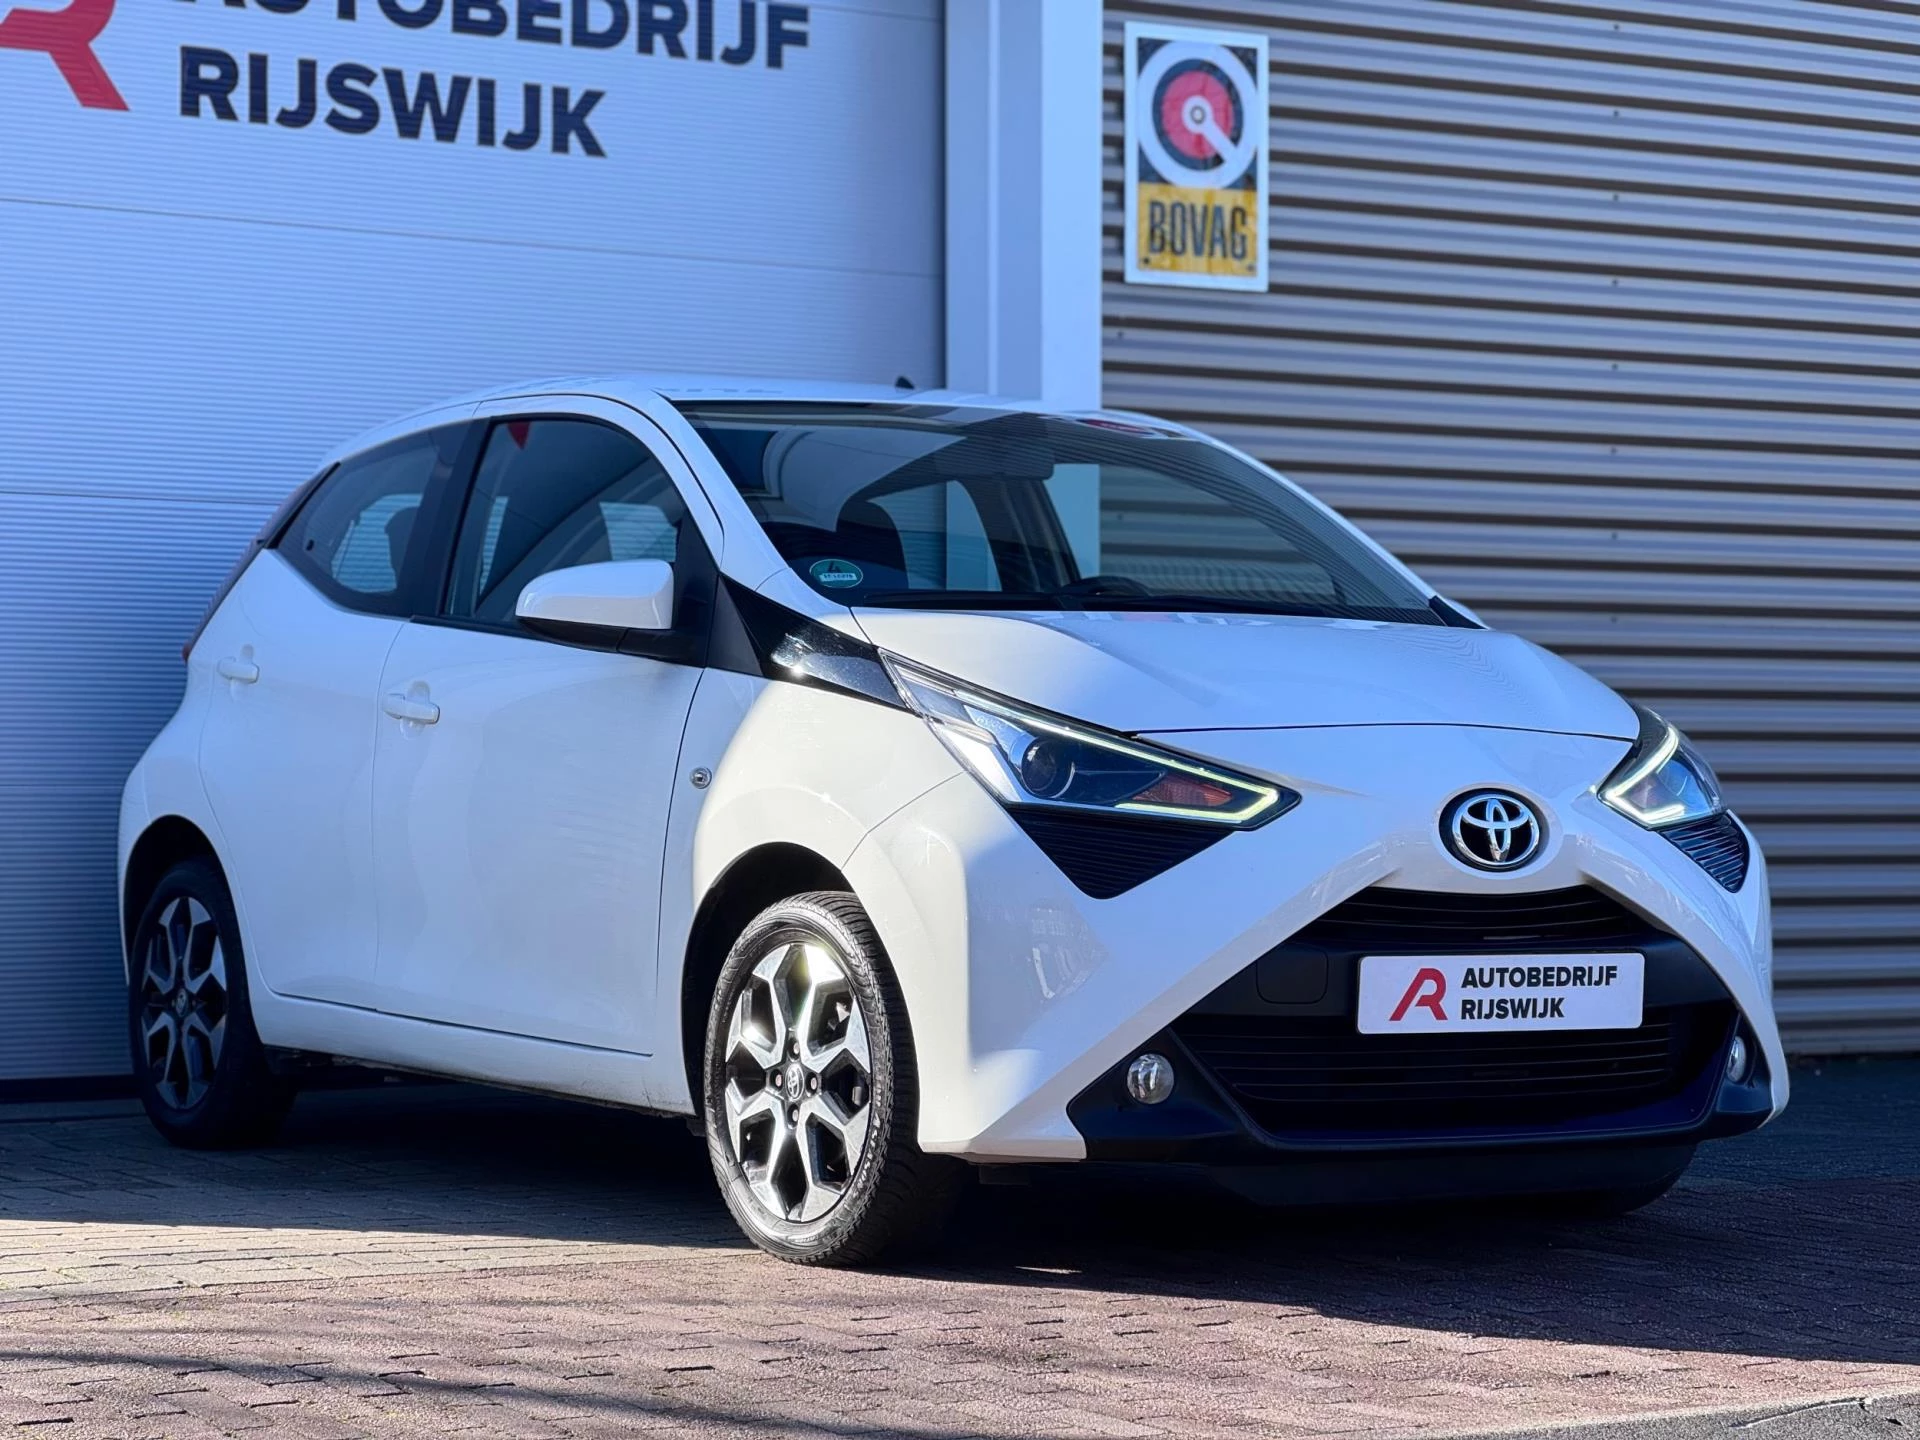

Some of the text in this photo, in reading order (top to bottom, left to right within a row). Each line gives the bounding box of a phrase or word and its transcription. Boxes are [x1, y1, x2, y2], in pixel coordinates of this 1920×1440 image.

[178, 0, 809, 69] BEDRIJF
[180, 45, 607, 158] RIJSWIJK
[1149, 200, 1247, 260] BOVAG
[1461, 966, 1617, 988] AUTOBEDRIJF
[1460, 998, 1565, 1020] RIJSWIJK
